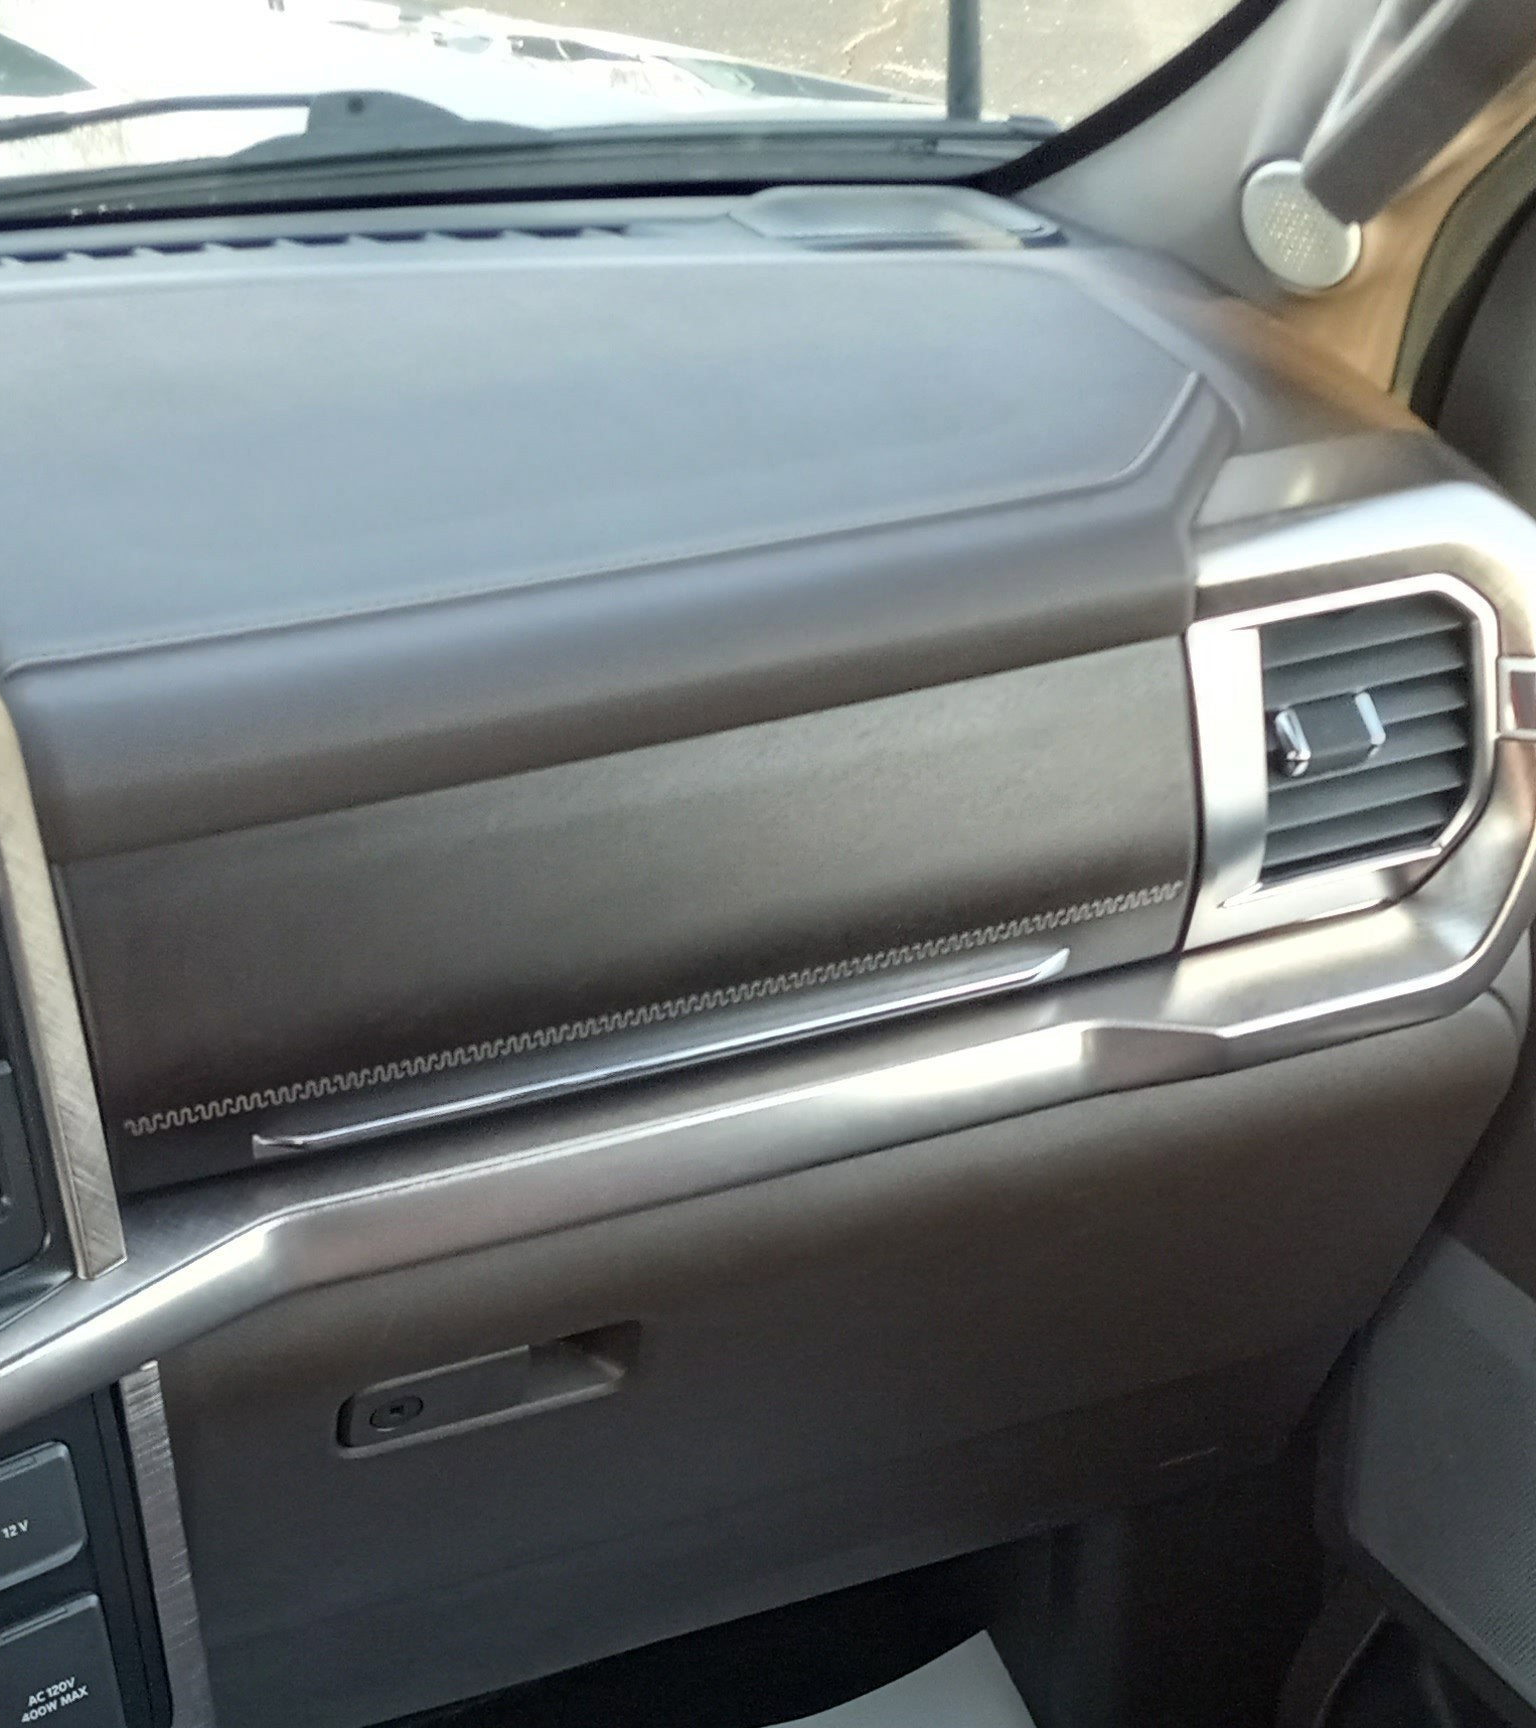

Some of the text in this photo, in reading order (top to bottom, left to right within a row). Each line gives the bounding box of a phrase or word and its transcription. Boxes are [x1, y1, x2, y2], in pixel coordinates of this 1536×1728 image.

[20, 1684, 89, 1724] 400W MAX
[27, 1676, 77, 1708] AC 120V
